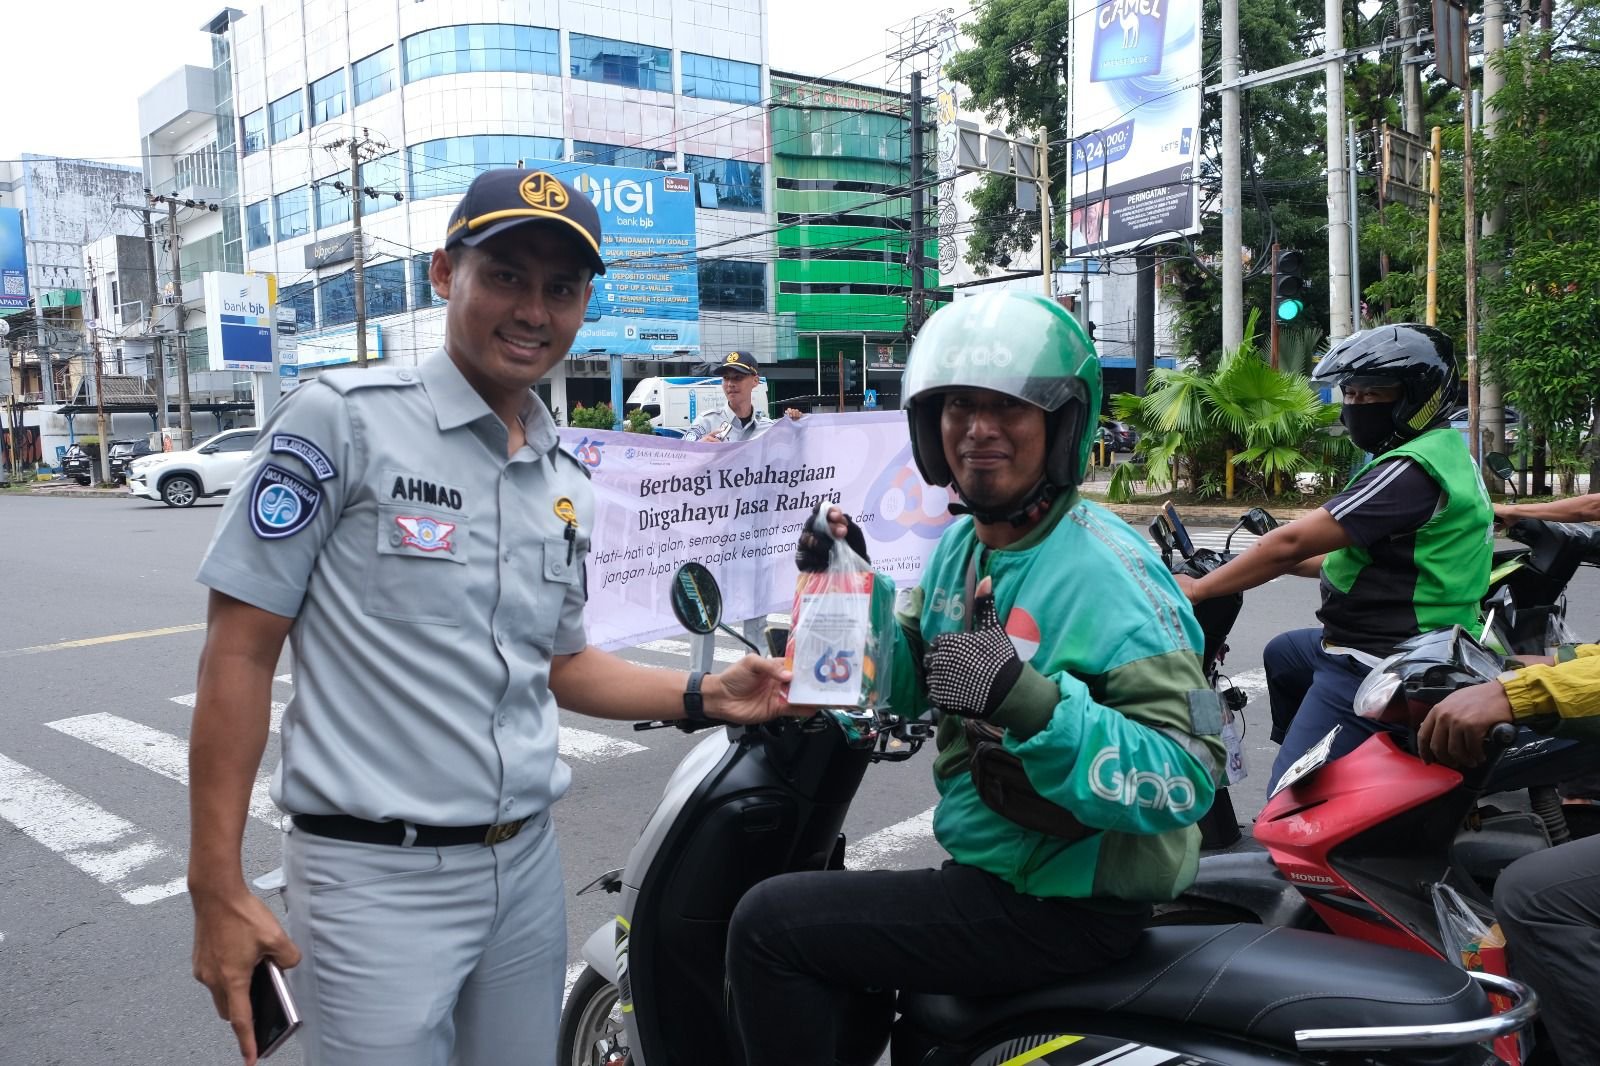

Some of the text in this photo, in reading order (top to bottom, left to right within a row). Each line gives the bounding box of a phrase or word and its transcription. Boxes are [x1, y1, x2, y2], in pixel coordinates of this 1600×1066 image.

[1099, 0, 1161, 29] CAMEL
[1161, 140, 1179, 153] LET'S
[574, 173, 654, 214] DIGI
[1127, 187, 1166, 205] PERINGATAN
[617, 216, 654, 229] bank bjb
[615, 236, 654, 245] TANDAMATA
[612, 272, 671, 281] DEPOSITO ONLINE
[223, 300, 248, 313] bank
[249, 302, 265, 316] bjb
[636, 450, 652, 458] JASA
[264, 470, 282, 483] JASA
[640, 462, 836, 498] Berbagi Kebahagiaan
[391, 476, 463, 510] AHMAD
[638, 502, 729, 531] Dirgahayu
[733, 496, 769, 520] Jasa
[594, 544, 644, 566] Hati-hati
[646, 541, 656, 557] di
[658, 537, 686, 558] jalan,
[689, 532, 737, 548] semoga
[740, 525, 779, 541] selamat
[855, 510, 875, 524] dan
[602, 568, 645, 589] jangan
[648, 562, 671, 579] lupa
[705, 549, 737, 569] pajak
[741, 540, 798, 560] kendaraan
[897, 561, 921, 572] Maju
[1088, 745, 1196, 813] Grab
[1290, 872, 1335, 883] HONDA
